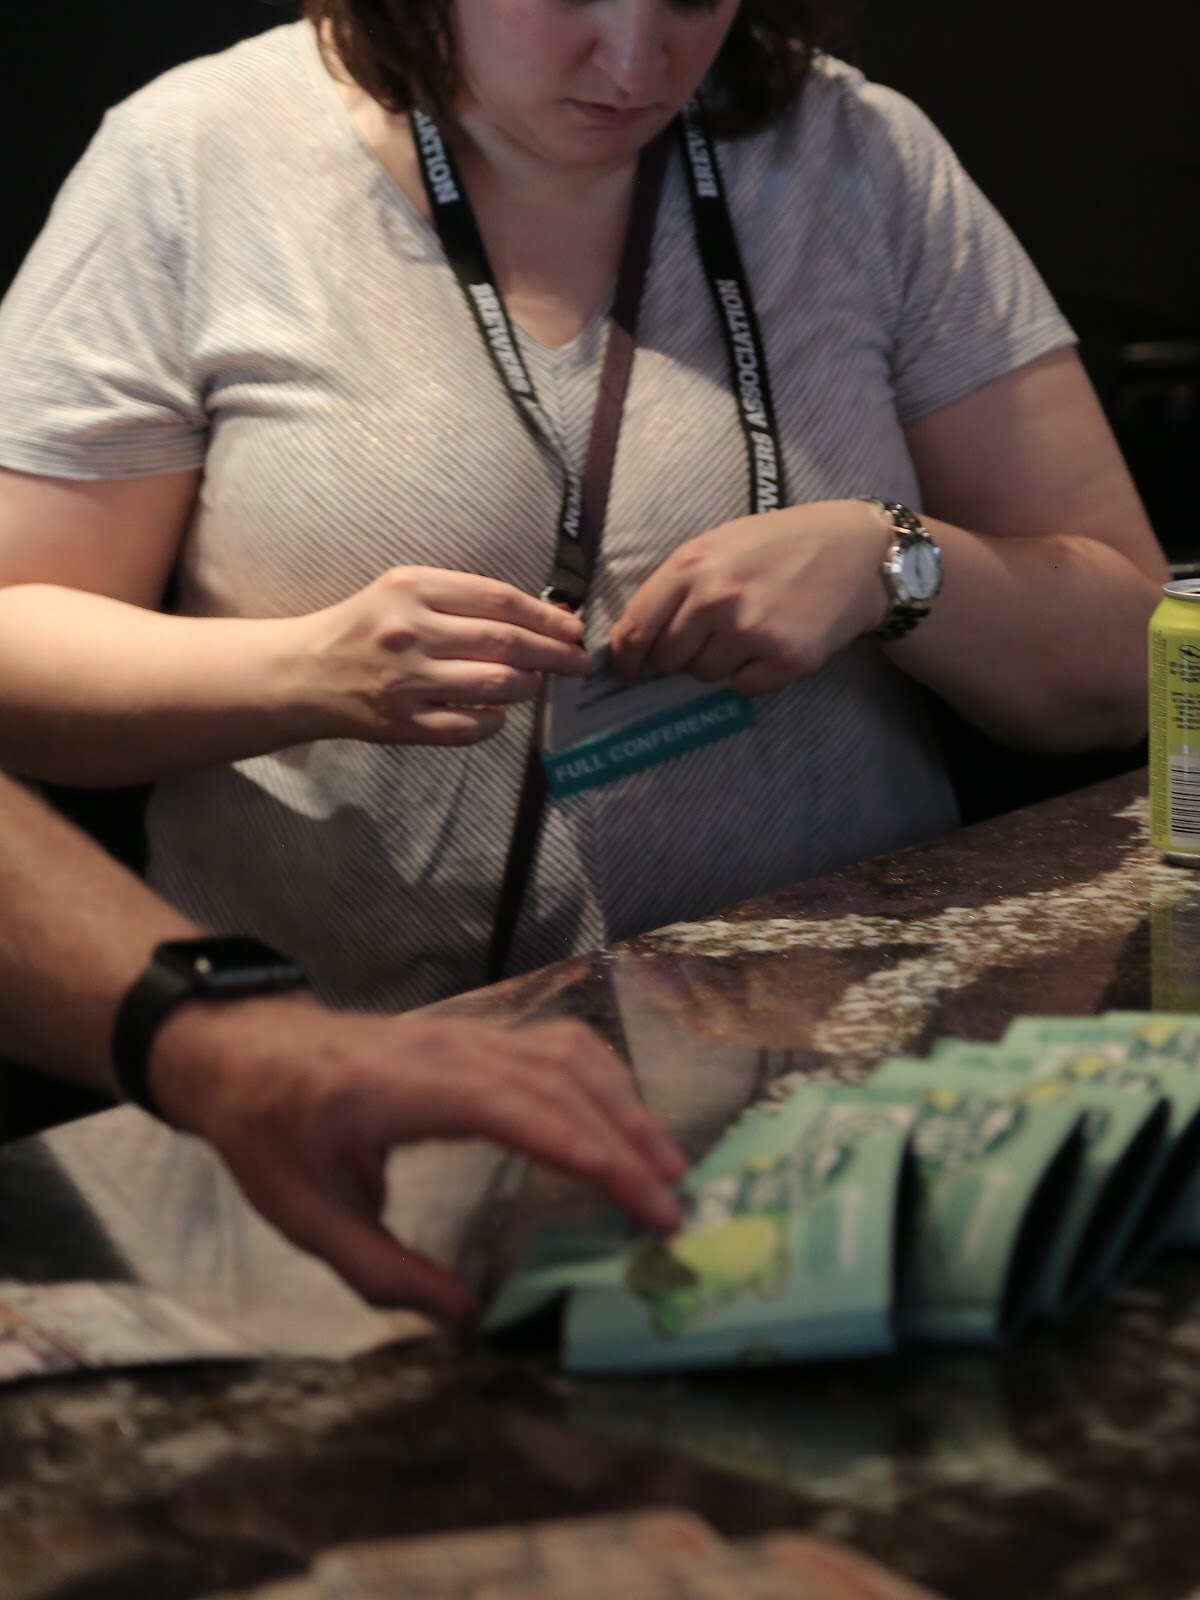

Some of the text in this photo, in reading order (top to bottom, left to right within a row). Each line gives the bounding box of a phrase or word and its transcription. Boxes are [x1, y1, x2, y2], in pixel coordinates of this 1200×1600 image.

[468, 281, 532, 394] BREWERS
[715, 278, 769, 429] ASSOCIATION
[554, 702, 742, 783] FULL CONFERENCE
